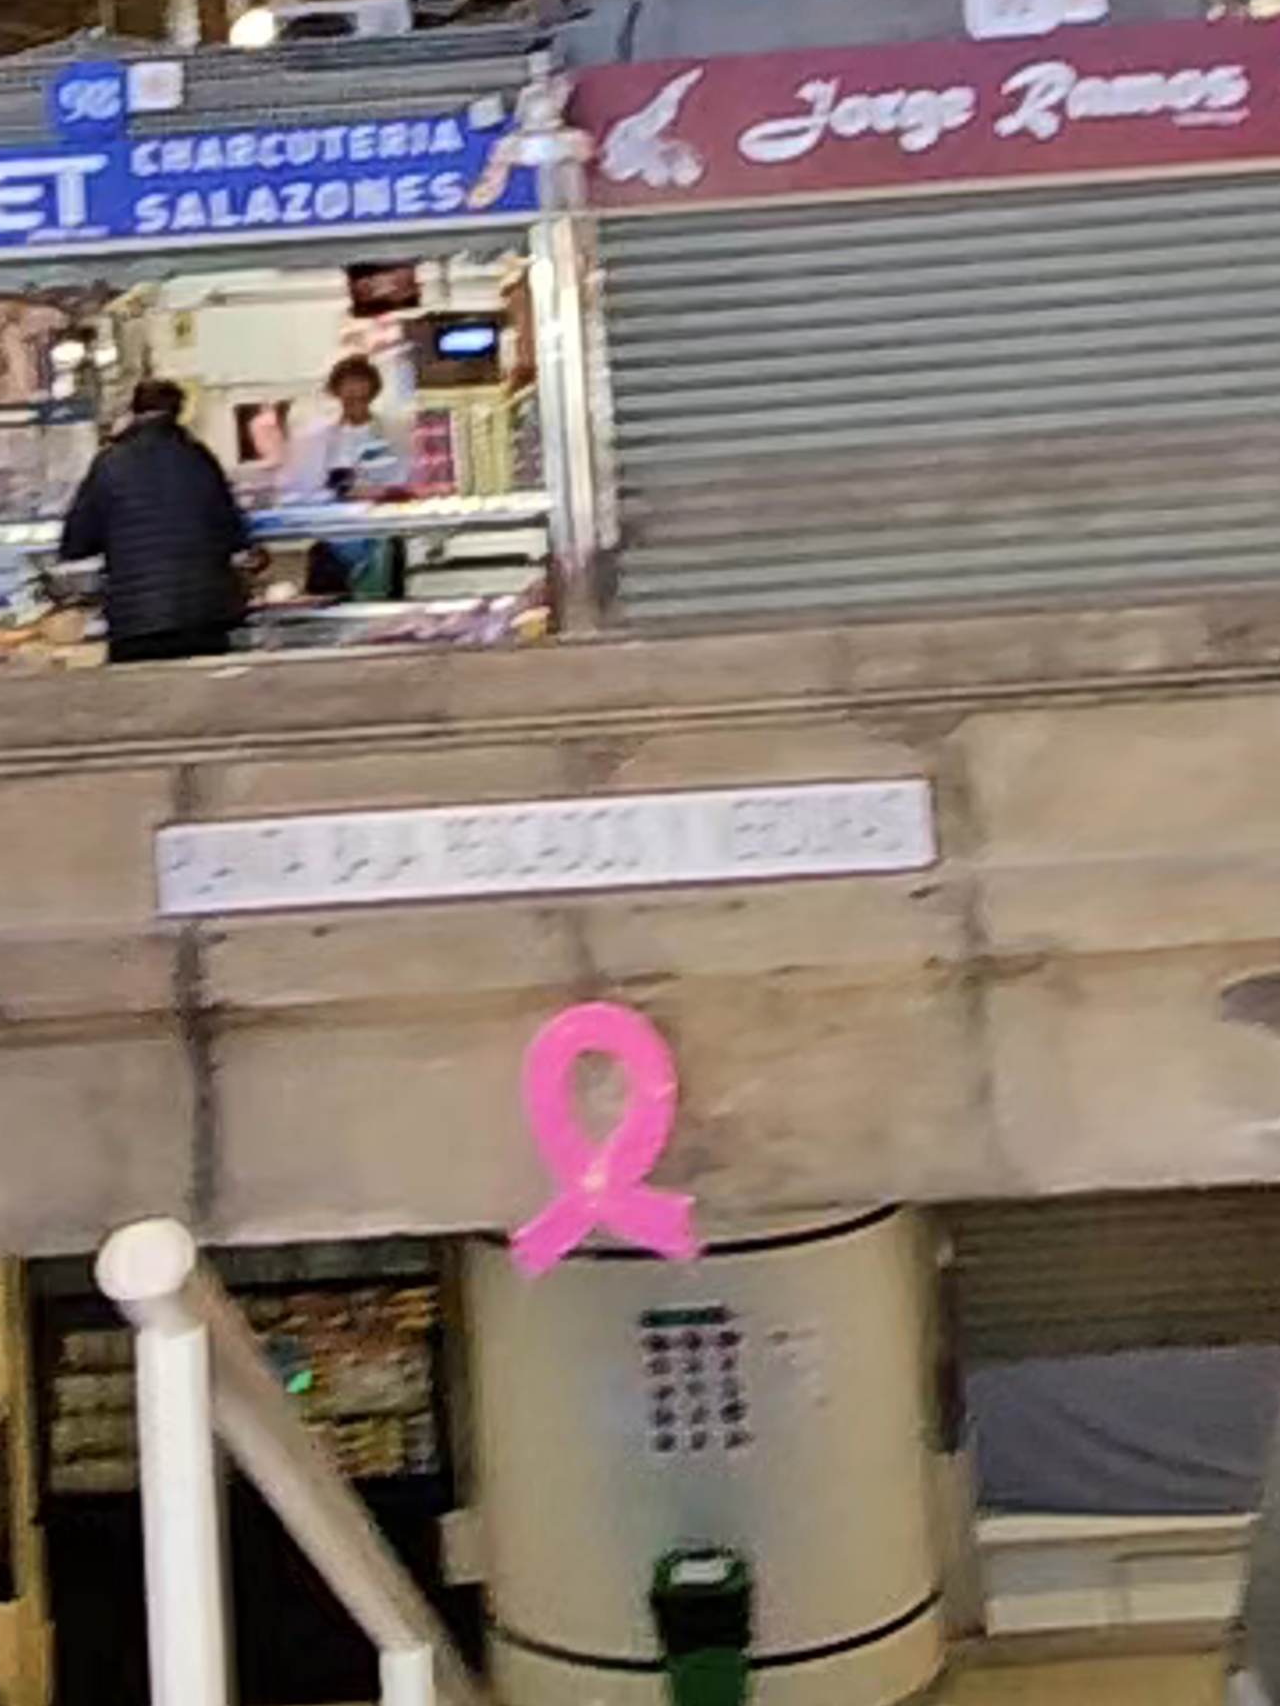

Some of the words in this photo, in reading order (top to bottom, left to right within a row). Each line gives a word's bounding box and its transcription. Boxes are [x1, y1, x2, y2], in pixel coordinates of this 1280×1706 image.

[737, 75, 977, 163] Jorge
[993, 60, 1252, 142] Ramos
[133, 171, 464, 234] SALAZONES
